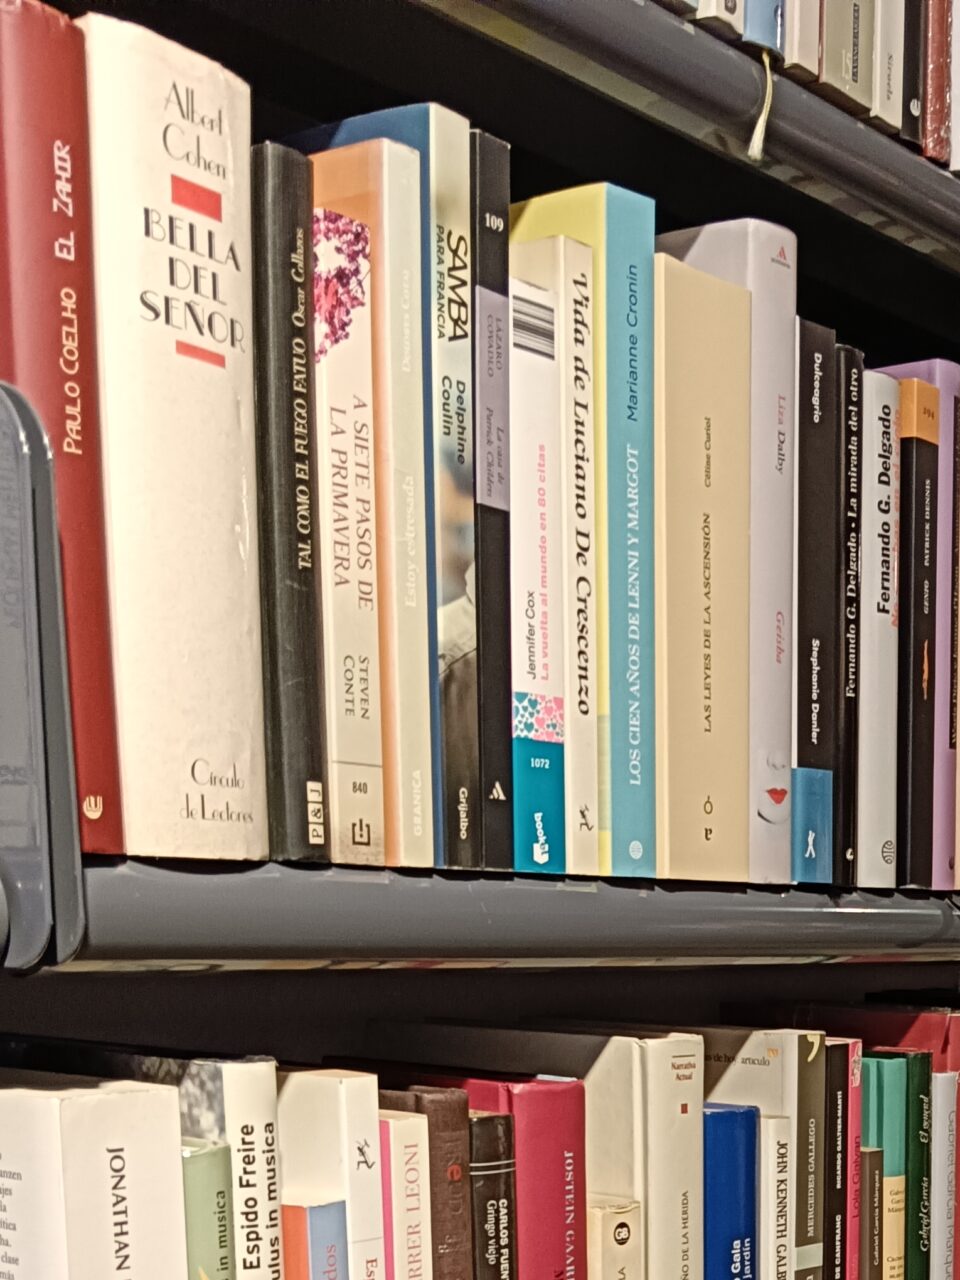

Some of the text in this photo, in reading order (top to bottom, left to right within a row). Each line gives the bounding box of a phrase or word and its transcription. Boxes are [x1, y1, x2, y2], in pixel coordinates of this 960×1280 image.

[163, 80, 225, 138] Albert
[161, 122, 228, 181] Cohen
[142, 206, 241, 272] BELLA
[52, 141, 84, 456] PAULO COELHO EL ZAHIR
[167, 255, 228, 306] DEL
[436, 224, 446, 339] PARA FRANCIA
[447, 229, 469, 343] SAMBA
[139, 288, 247, 354] SEÑOR
[626, 264, 639, 422] Marianne Cronin
[441, 375, 453, 437] Coulin
[812, 352, 823, 424] Dulceagrio
[455, 379, 467, 465] Delphine
[775, 430, 786, 475] Dalby
[876, 404, 892, 615] Fernando G. Delgado
[525, 591, 536, 680] Jennifer Cox
[625, 444, 641, 786] LOS CIEN AÑOS DE LENNI Y MARGOT
[702, 512, 713, 733] LAS LEYES DE LA ASCENSIÓN
[342, 654, 356, 717] CONTE
[358, 655, 371, 721] STEVEN
[811, 638, 820, 745] Stephanie Danler
[351, 781, 368, 795] 840
[530, 757, 550, 769] 1072
[262, 1121, 278, 1202] musica
[776, 1140, 789, 1174] JOHN
[807, 1118, 816, 1168] GALLEGO
[106, 1146, 131, 1271] JONATHAN
[238, 1123, 262, 1270] Espido Freire
[403, 1142, 423, 1214] LEONI
[563, 1150, 575, 1231] JOSTEIN
[776, 1179, 788, 1239] KENNETH
[807, 1170, 815, 1237] MERCEDES
[265, 1209, 279, 1230] in
[498, 1198, 508, 1249] CARLOS
[731, 1240, 741, 1274] Gala
